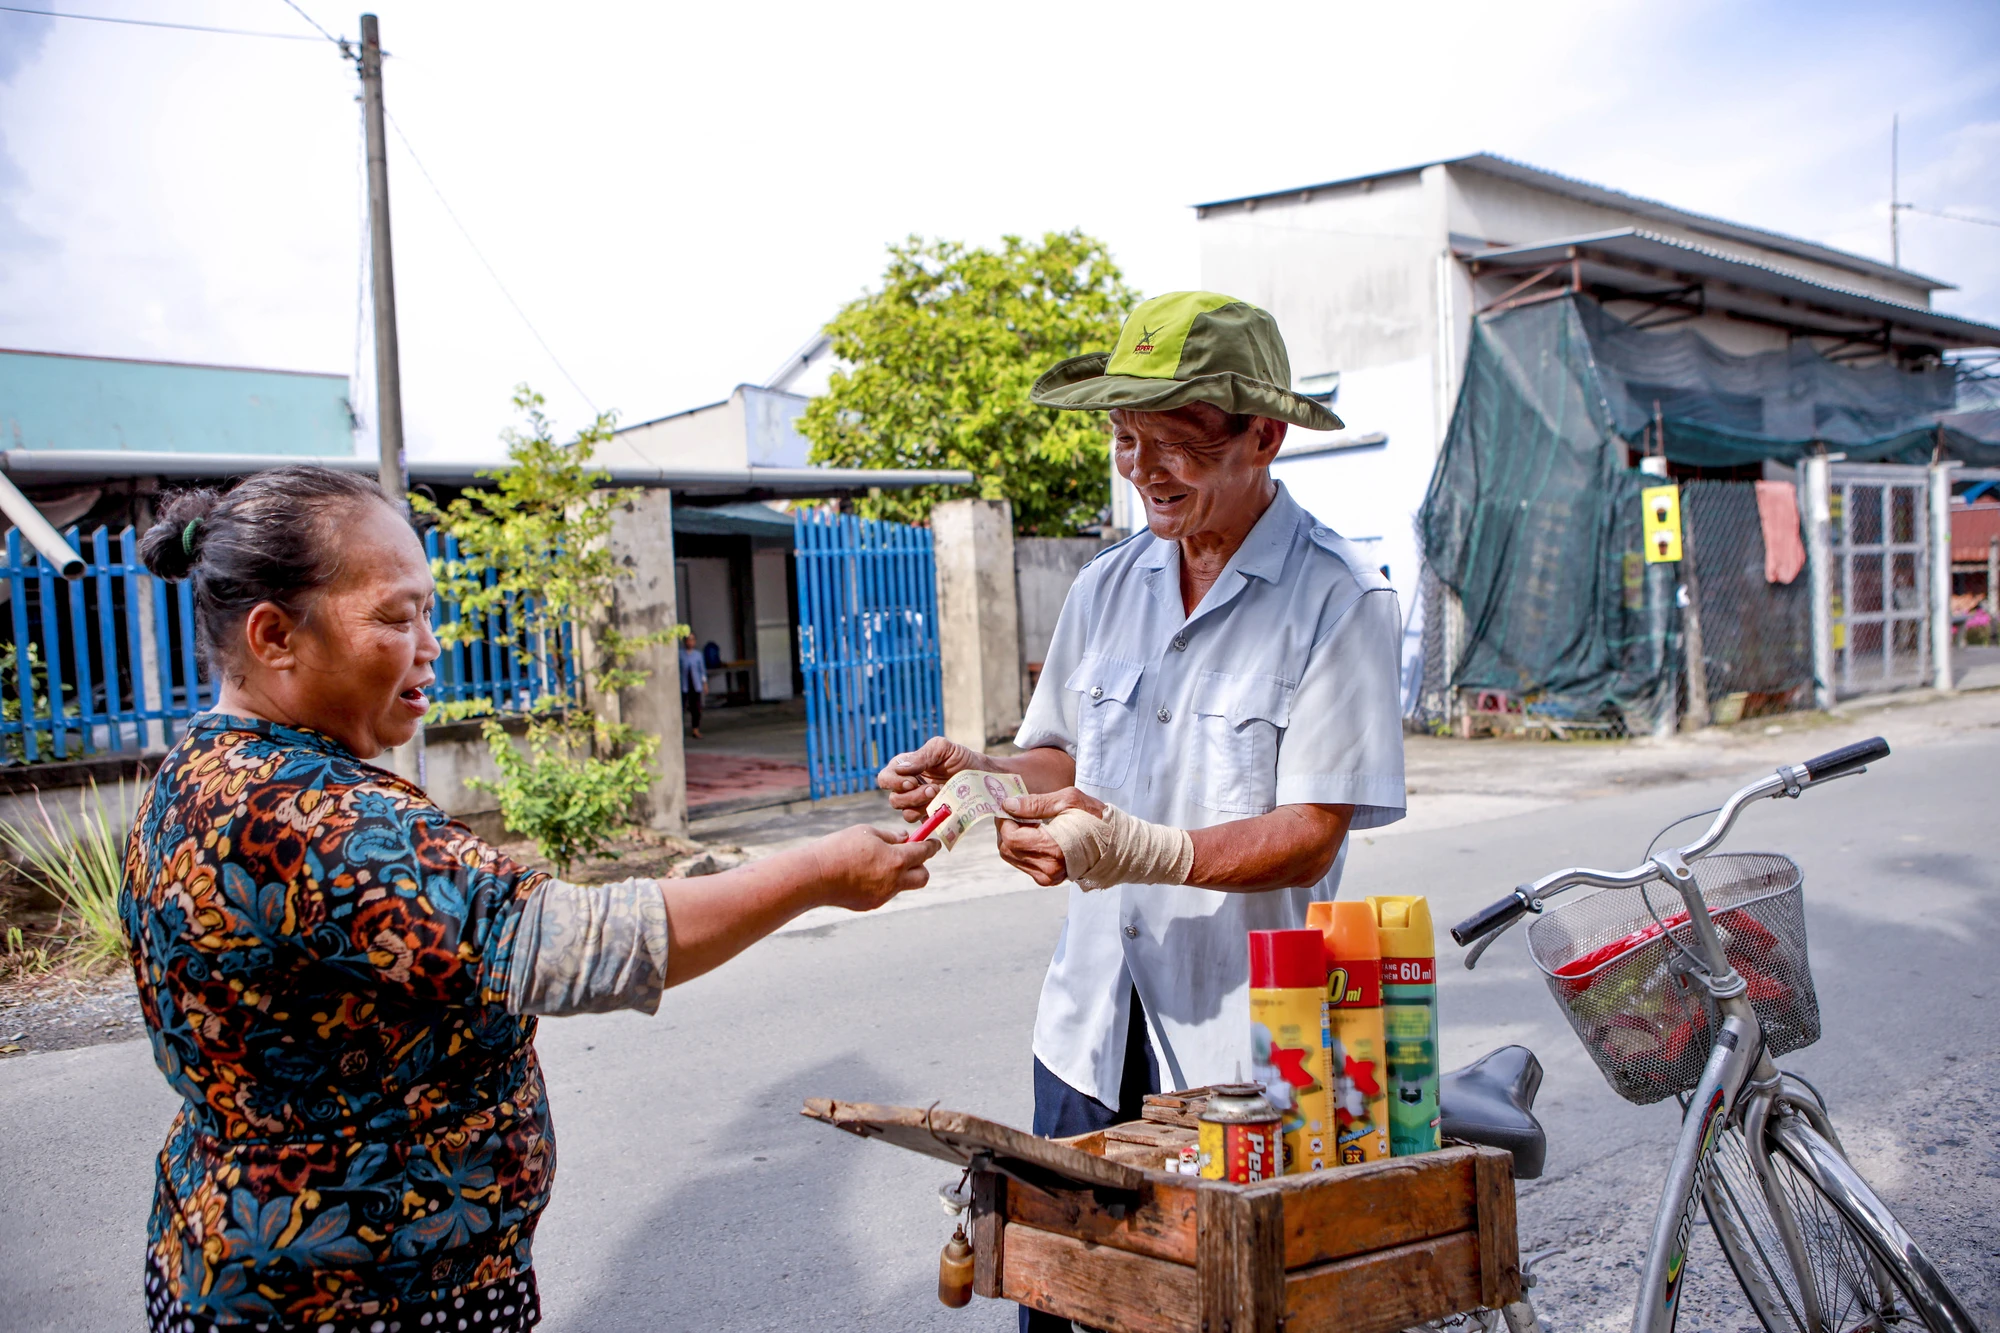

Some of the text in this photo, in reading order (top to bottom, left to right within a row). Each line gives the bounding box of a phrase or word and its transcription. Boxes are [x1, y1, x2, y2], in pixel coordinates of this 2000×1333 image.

[1400, 962, 1431, 980] 60 ml
[1327, 967, 1362, 1005] 0 ml
[1346, 1154, 1360, 1163] 2X
